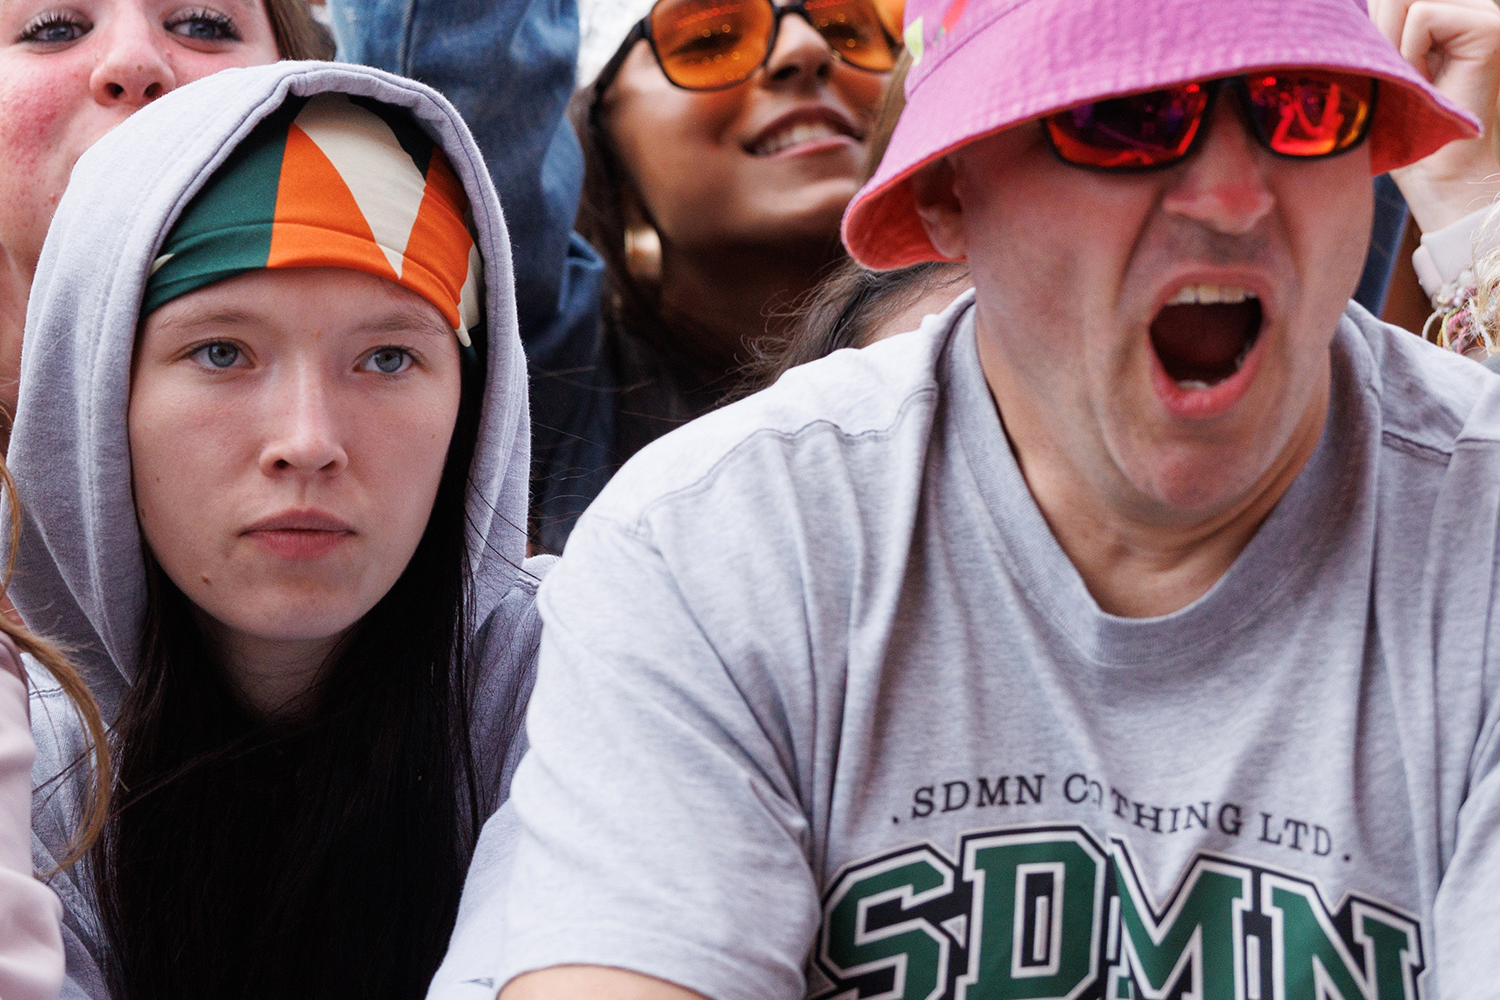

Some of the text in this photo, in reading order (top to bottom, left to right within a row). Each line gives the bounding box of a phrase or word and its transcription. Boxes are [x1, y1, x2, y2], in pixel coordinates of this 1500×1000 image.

[911, 773, 1045, 820] SDMN
[1063, 773, 1243, 837] CTHING
[816, 825, 1429, 1000] SDMN
